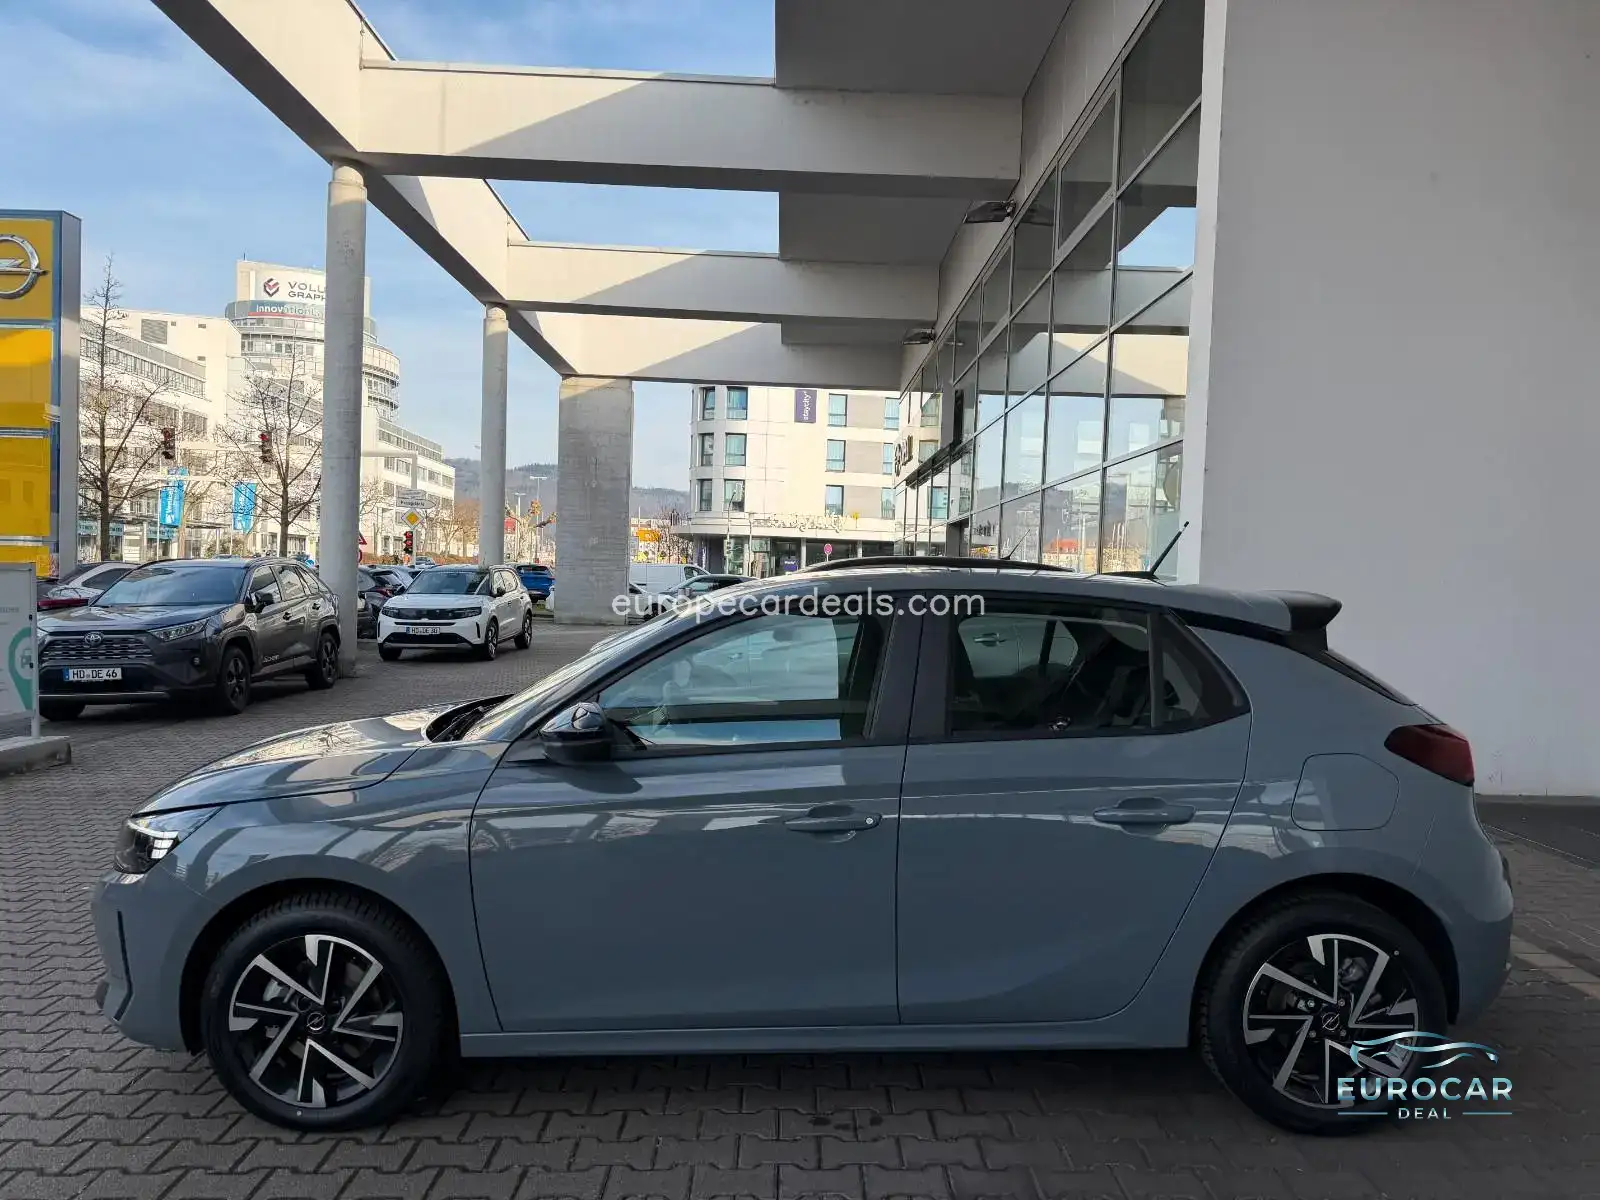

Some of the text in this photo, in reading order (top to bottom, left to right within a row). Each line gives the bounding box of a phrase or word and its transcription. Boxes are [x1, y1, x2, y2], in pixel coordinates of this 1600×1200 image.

[72, 669, 118, 679] HD DE 46
